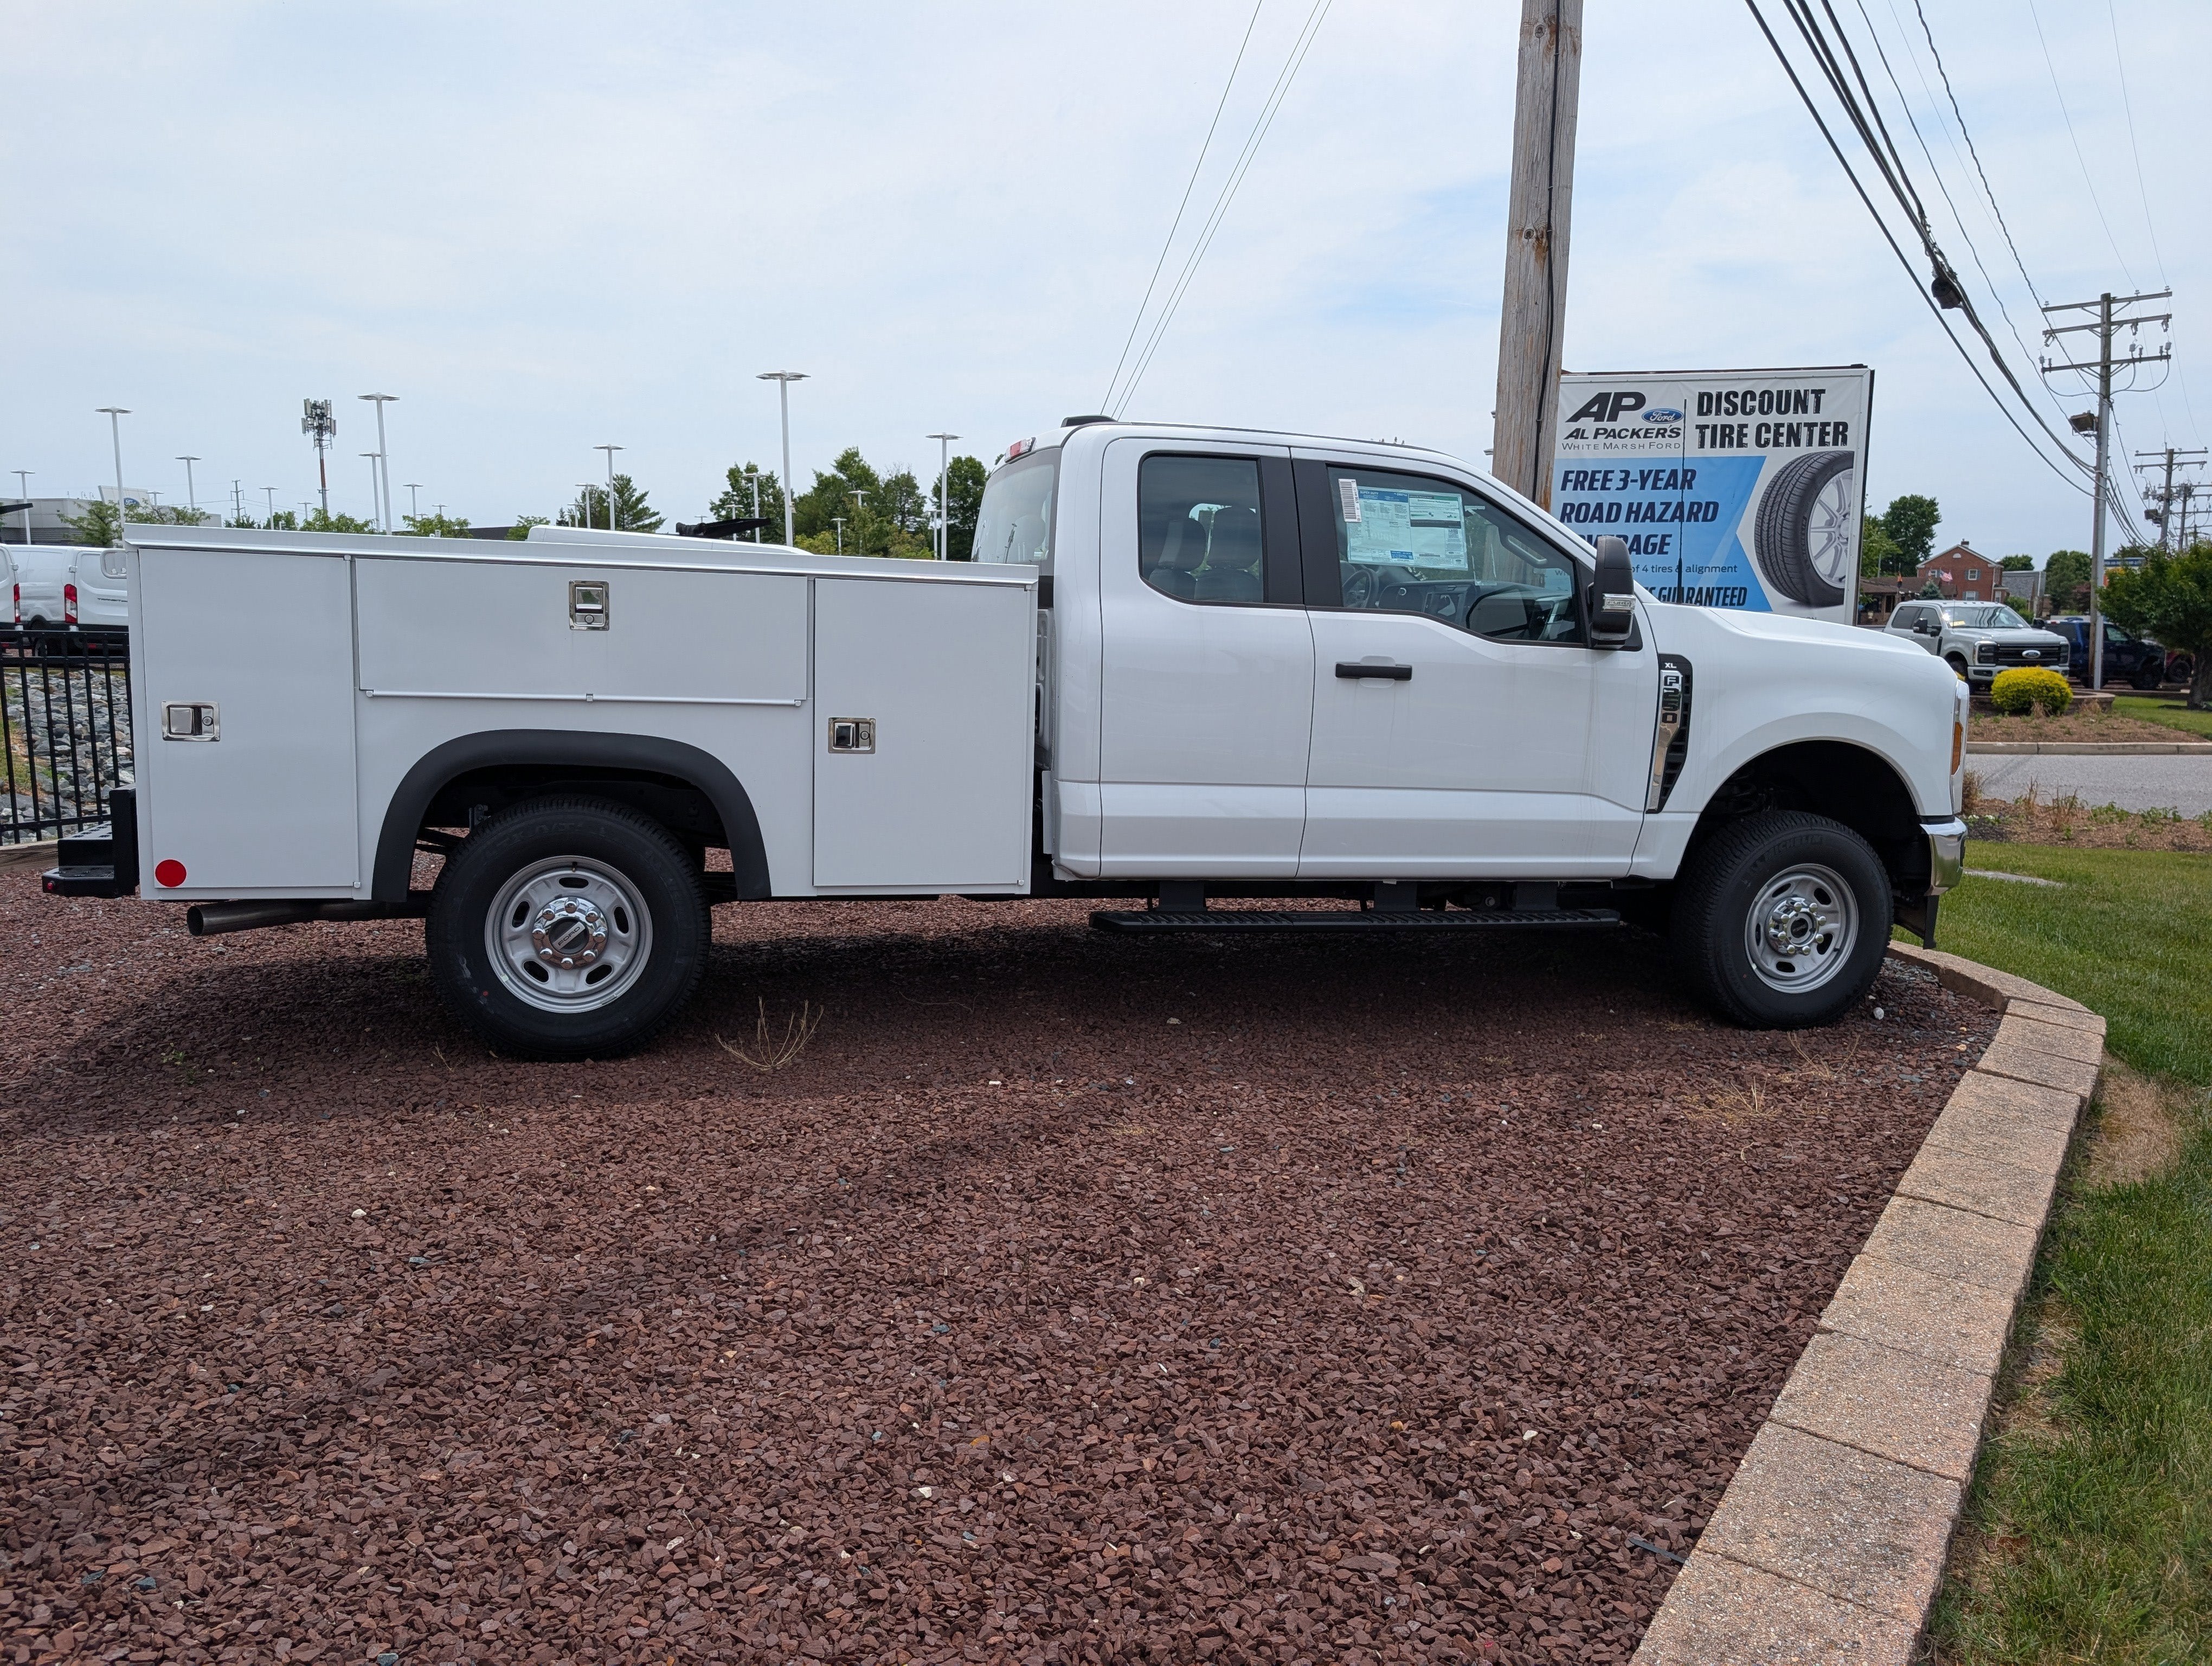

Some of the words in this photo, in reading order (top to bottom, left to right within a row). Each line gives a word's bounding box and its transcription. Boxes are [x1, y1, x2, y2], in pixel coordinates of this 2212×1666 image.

[1565, 391, 1646, 422] AP
[1697, 389, 1826, 416] DISCOUNT
[1650, 411, 1675, 421] Ford
[1563, 428, 1589, 440] AL
[1593, 425, 1682, 439] PACKER'S
[1695, 423, 1748, 448] TIRE
[1755, 421, 1849, 448] CENTER
[1561, 442, 1599, 450] WHITE
[1560, 470, 1615, 491] FREE
[1615, 469, 1697, 491] 3-YEAR
[1559, 502, 1622, 523] ROAD
[1624, 501, 1719, 523] HAZARD
[1642, 565, 1648, 573] 4
[1651, 564, 1673, 573] tires
[1685, 564, 1738, 574] alignment
[558, 926, 581, 946] FORD
